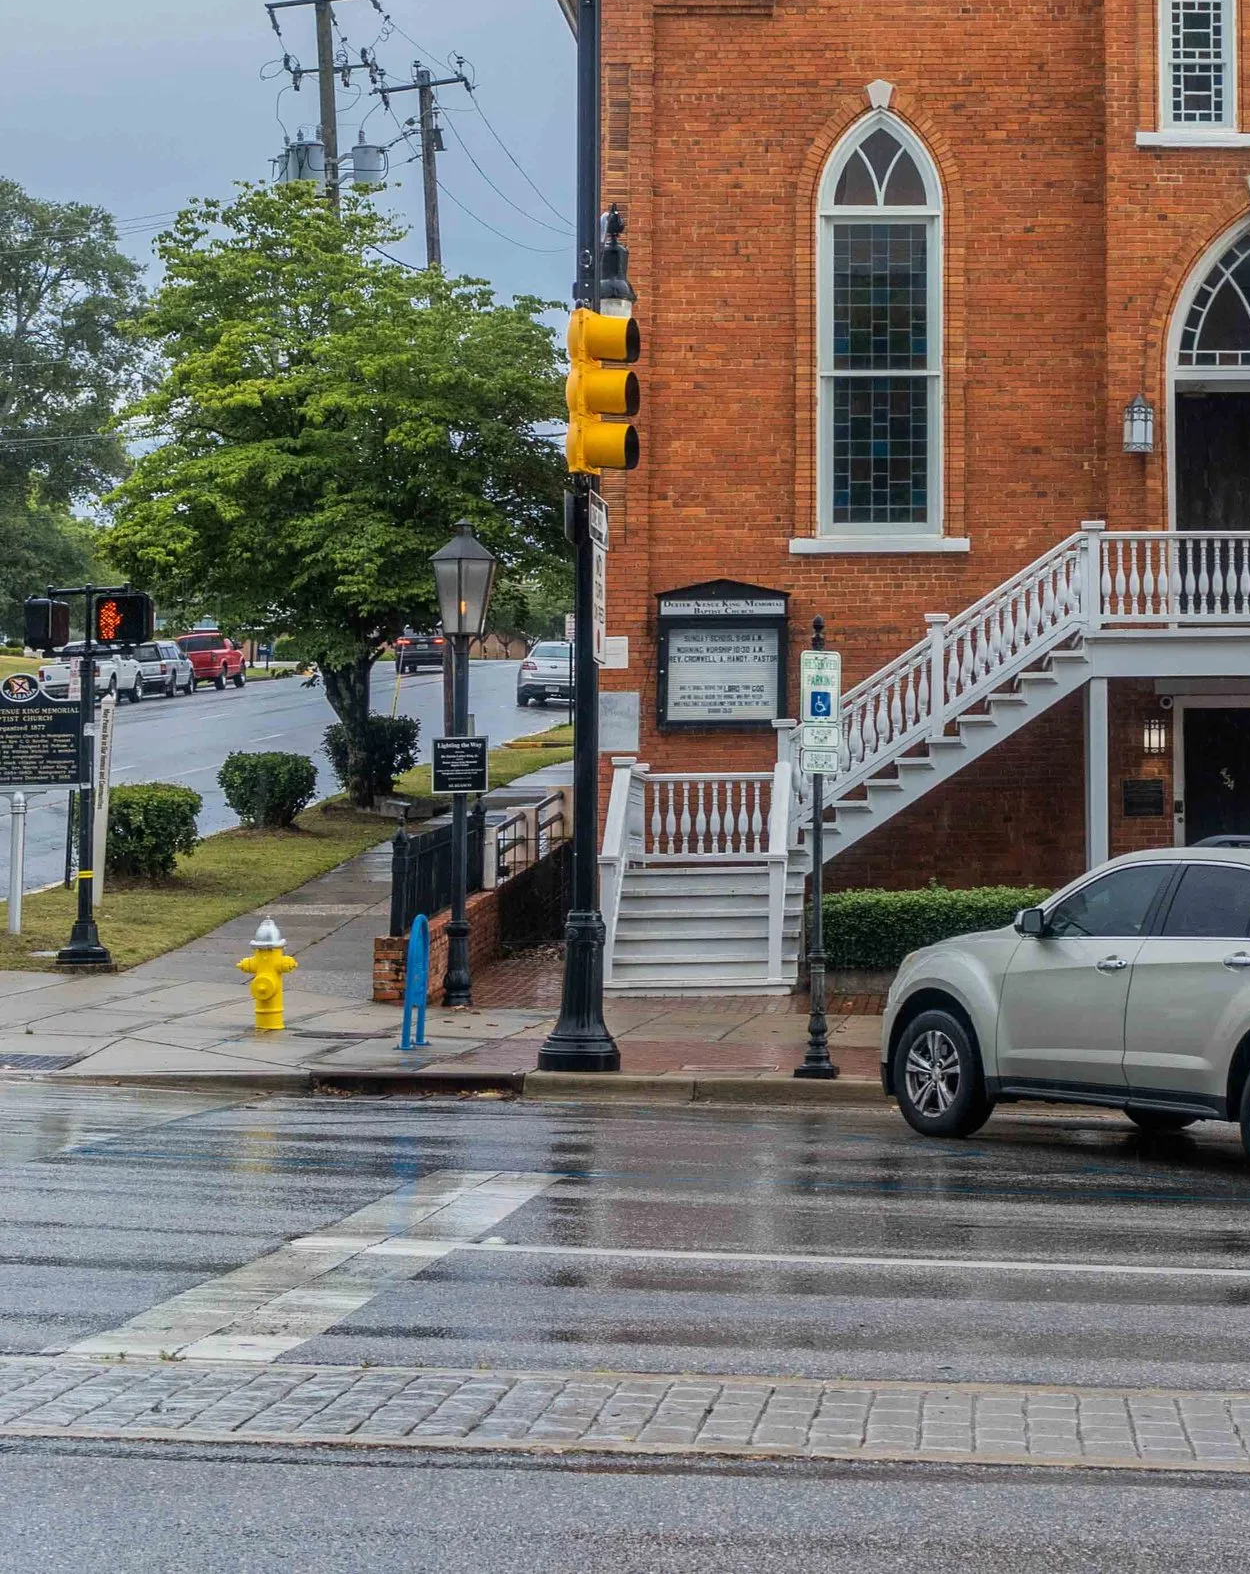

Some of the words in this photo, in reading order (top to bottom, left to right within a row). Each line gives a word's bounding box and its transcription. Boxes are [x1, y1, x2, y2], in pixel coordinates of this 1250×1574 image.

[684, 655, 716, 663] CROMWELL
[753, 655, 779, 663] PASTOR
[807, 674, 836, 686] PARKING
